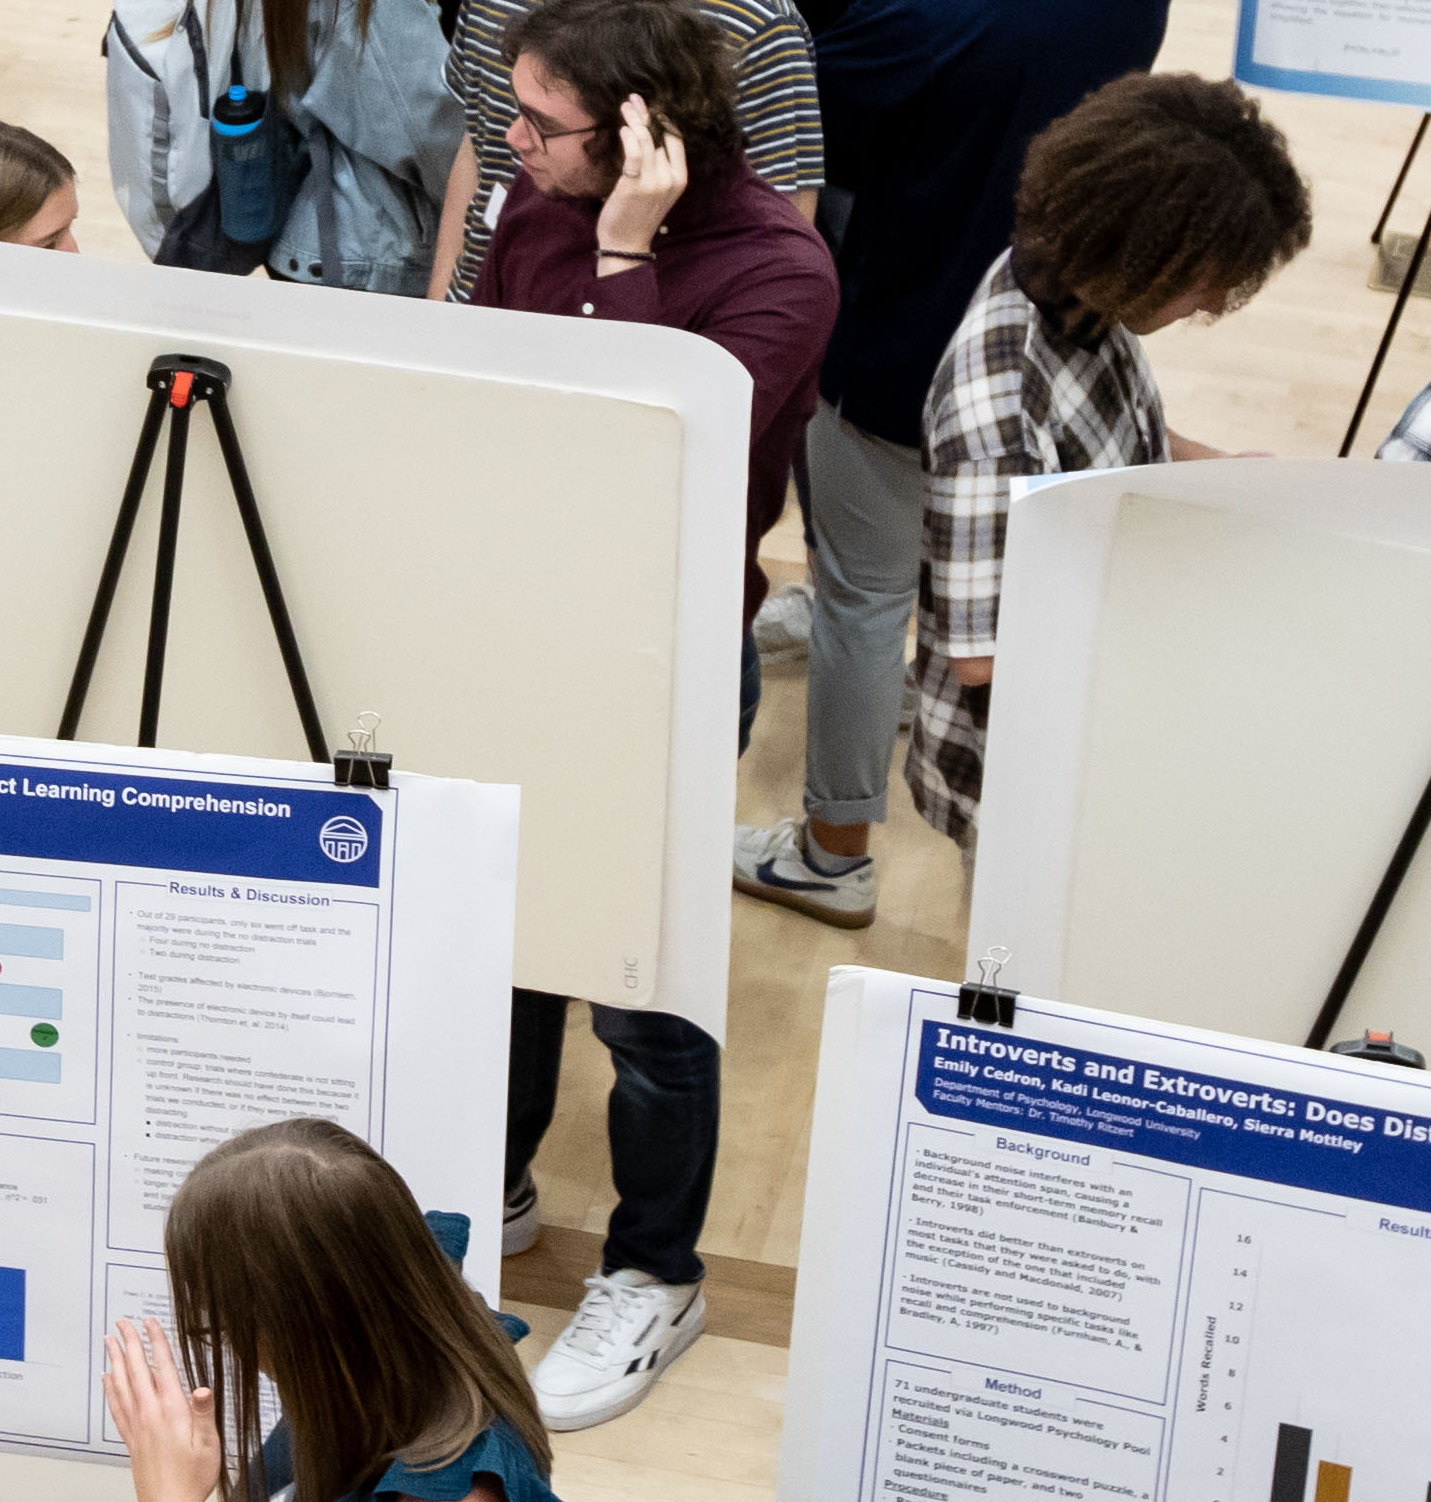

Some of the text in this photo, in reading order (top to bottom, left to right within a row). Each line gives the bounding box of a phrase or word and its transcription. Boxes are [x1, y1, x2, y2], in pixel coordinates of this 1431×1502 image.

[22, 777, 115, 807] Learning
[121, 786, 290, 817] Comprehension
[169, 881, 330, 906] Results & Discussion
[936, 1027, 1076, 1072] Introverts
[1083, 1061, 1134, 1084] and
[1143, 1069, 1295, 1116] Extroverts:
[1305, 1100, 1374, 1131] Does
[932, 1089, 1134, 1137] Faculty Mentors: Dr. Timothy Ritzert
[933, 1056, 1363, 1153] Emily Cedron, Kadi Leonor-Caballero, Sierra Mottley
[933, 1076, 1200, 1140] Department of Psychology, Longwood University
[996, 1136, 1090, 1166] Background
[984, 1377, 1041, 1399] Method
[1196, 1316, 1218, 1412] Words Recalled
